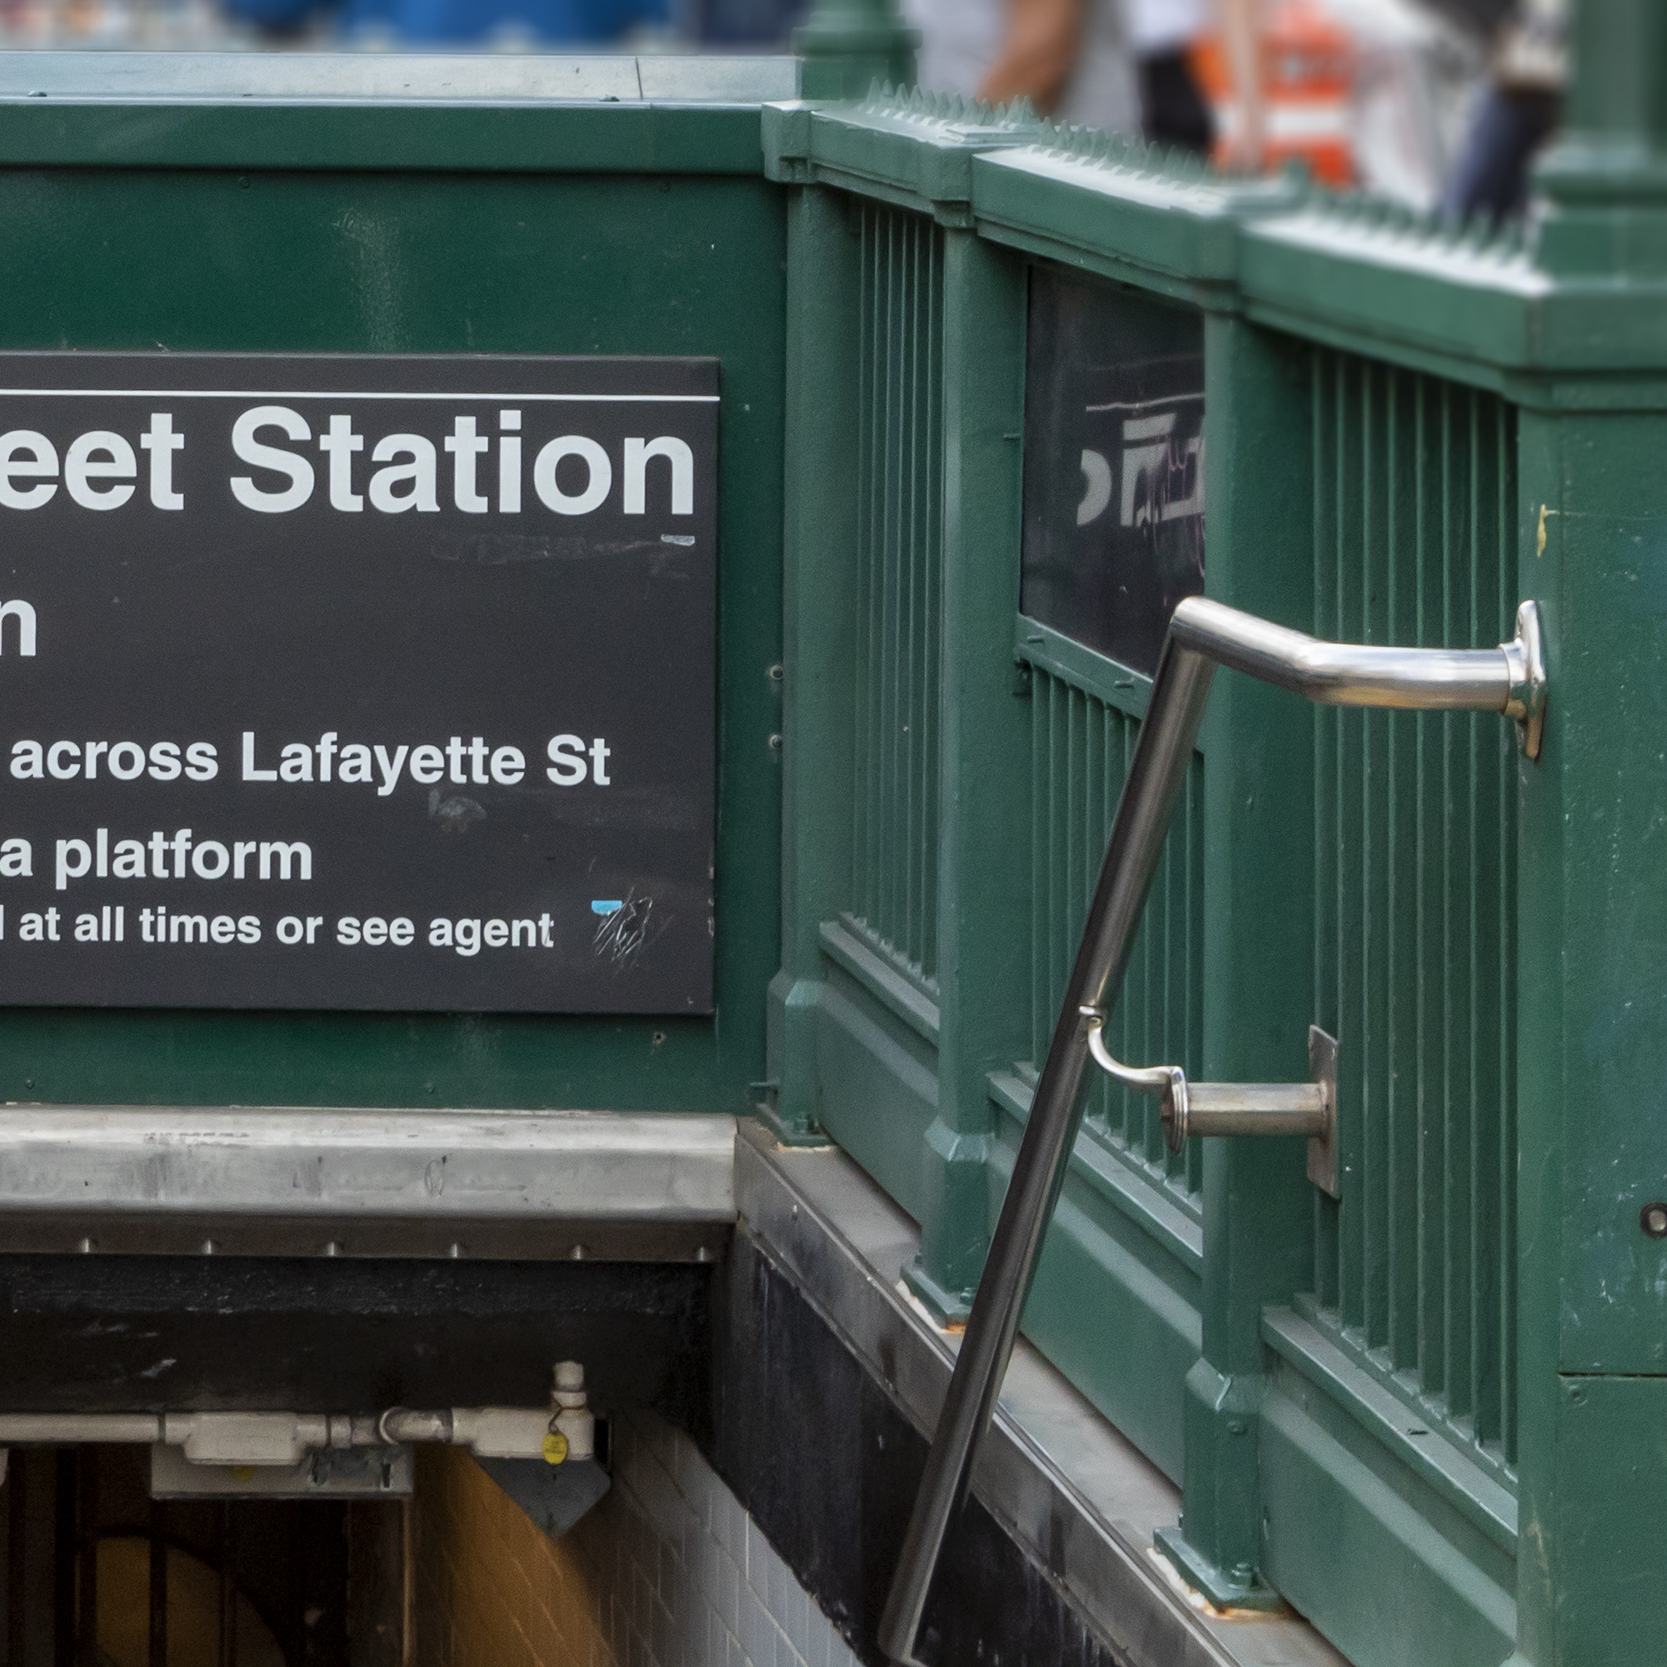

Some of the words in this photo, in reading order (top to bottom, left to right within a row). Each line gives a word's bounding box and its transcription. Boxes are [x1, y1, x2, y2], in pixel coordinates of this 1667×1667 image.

[230, 406, 693, 515] Station
[10, 740, 218, 781] across
[242, 732, 525, 796] Lafayette
[547, 734, 610, 786] St
[56, 828, 311, 890] platform
[19, 907, 60, 941] at
[74, 906, 124, 941] all
[139, 906, 261, 943] times
[276, 916, 323, 944] or
[337, 917, 414, 946] see
[429, 913, 554, 956] agent
